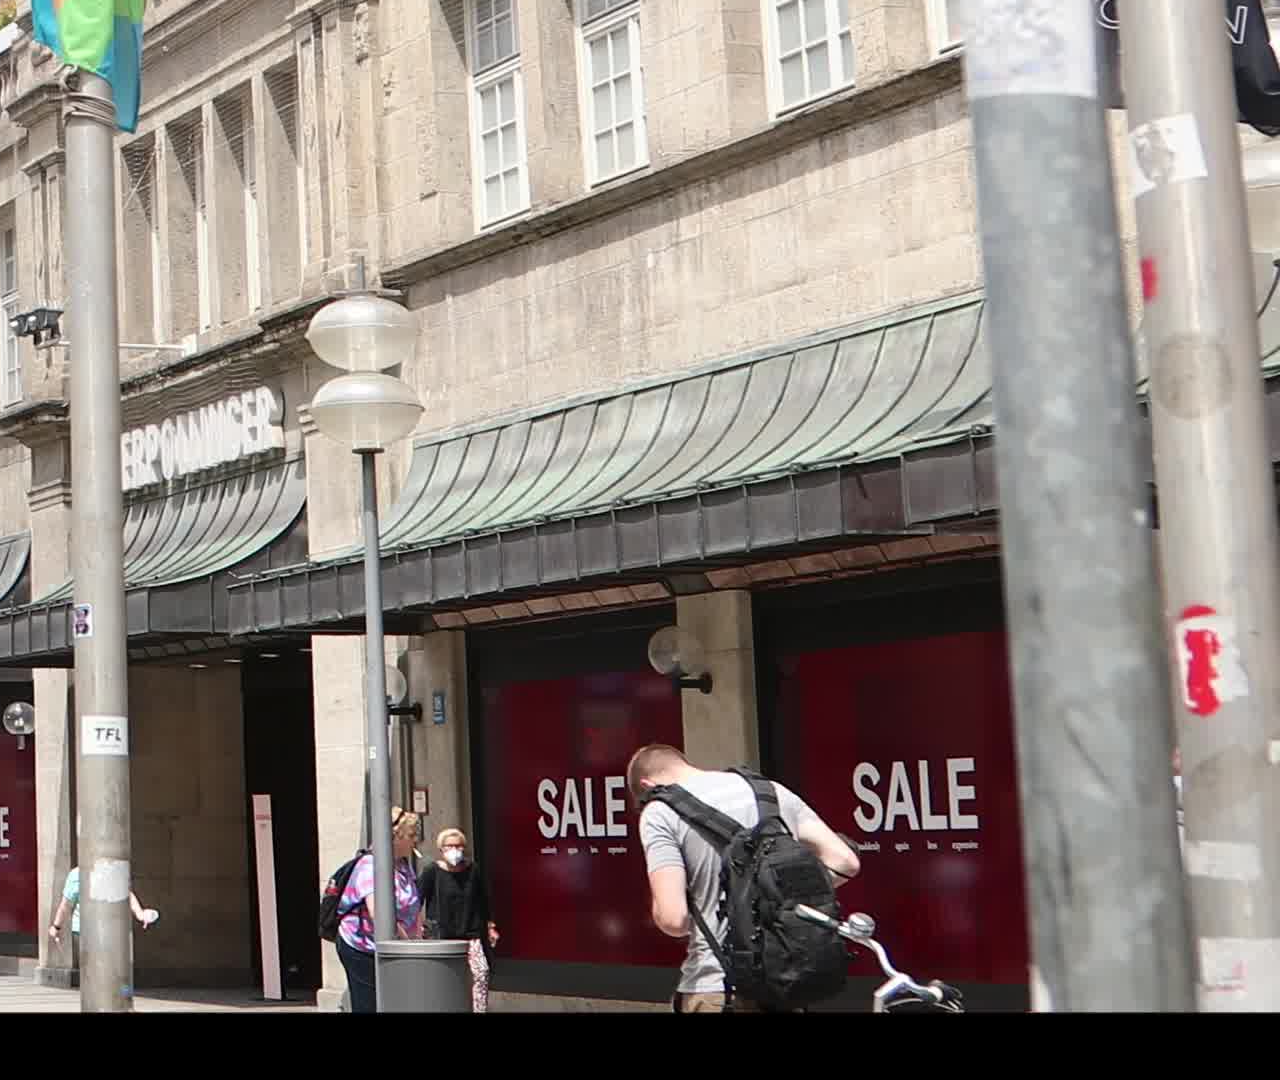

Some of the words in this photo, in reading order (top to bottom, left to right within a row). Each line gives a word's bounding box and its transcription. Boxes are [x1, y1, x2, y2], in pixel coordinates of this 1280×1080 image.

[93, 726, 122, 742] TFL
[537, 775, 627, 839] SALE
[853, 757, 979, 833] SALE
